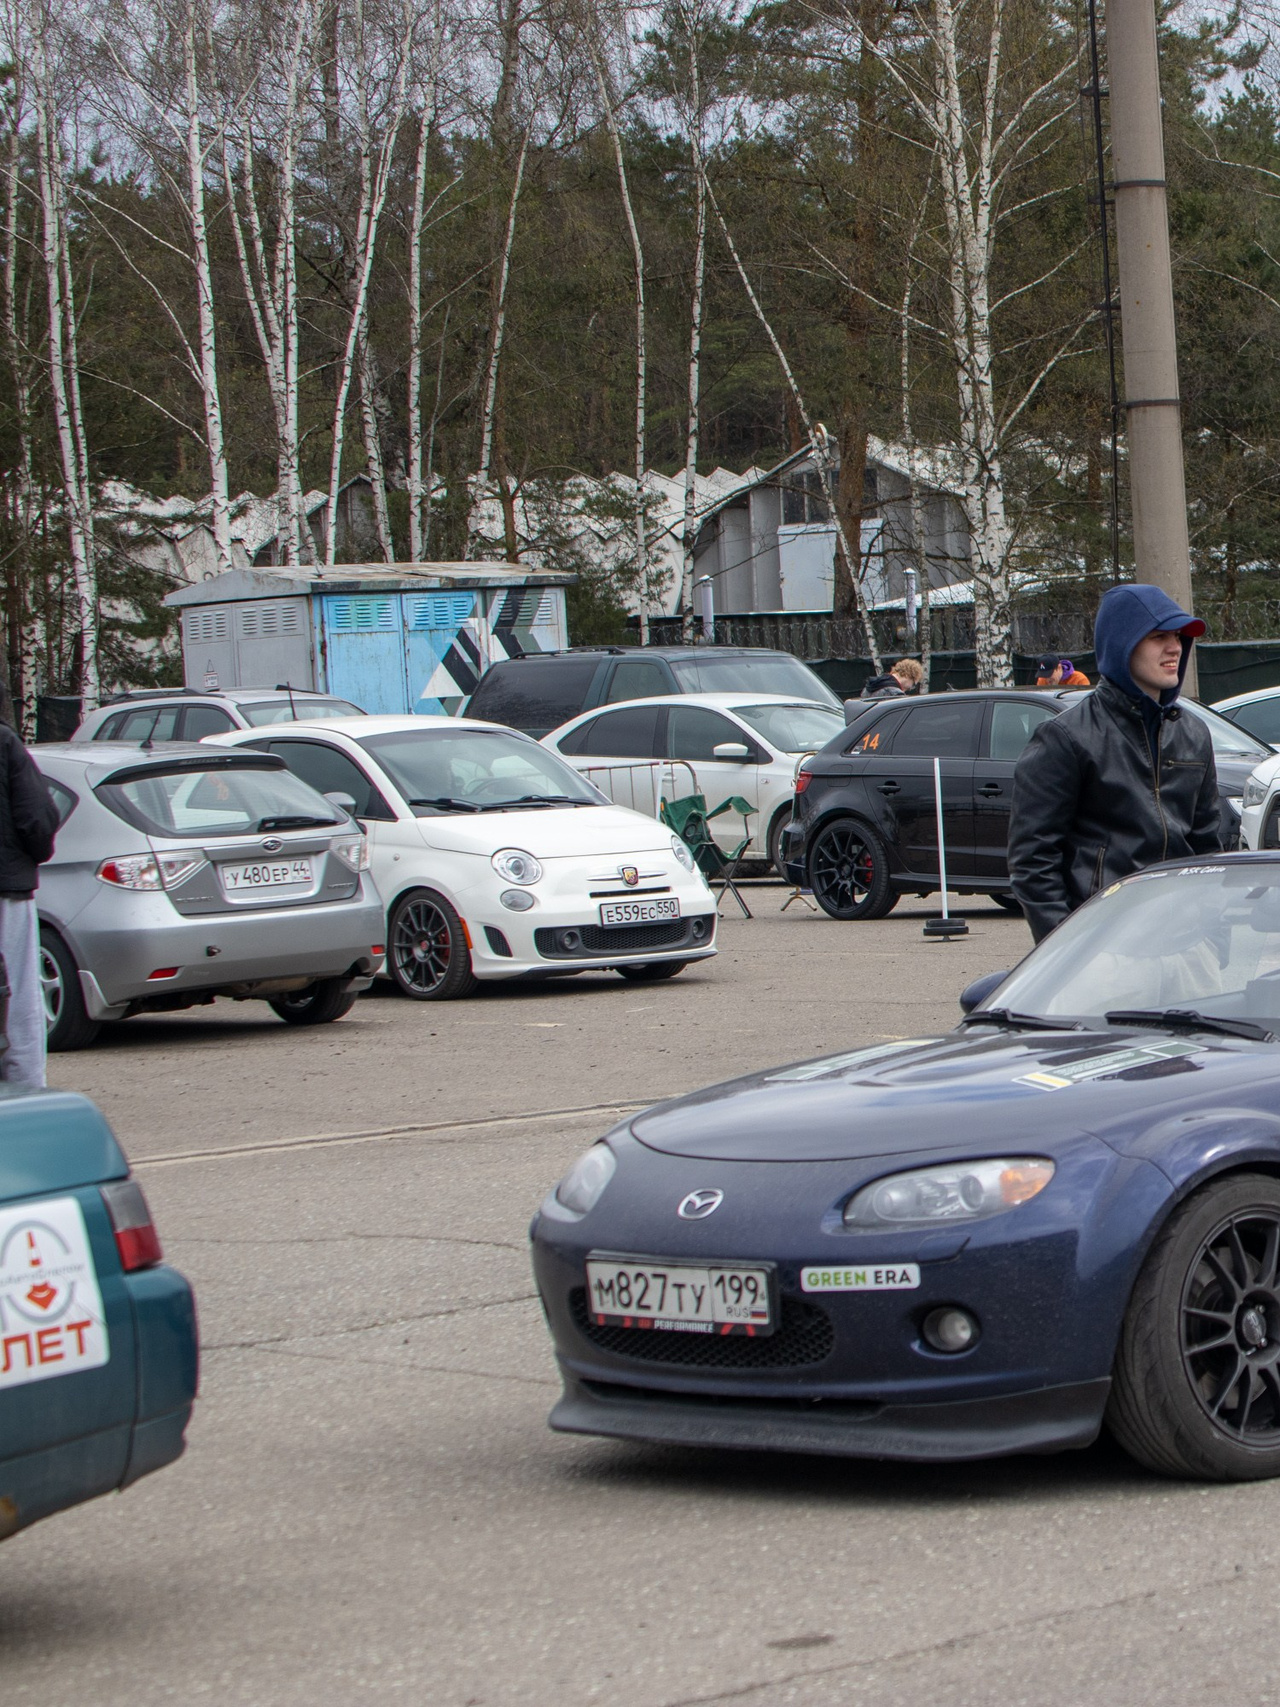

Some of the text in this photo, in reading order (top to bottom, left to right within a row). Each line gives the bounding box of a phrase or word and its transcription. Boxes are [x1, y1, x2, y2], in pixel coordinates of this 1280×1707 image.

[863, 733, 880, 750] 14
[293, 862, 307, 876] 44
[657, 901, 676, 914] 550
[807, 1269, 911, 1286] GREEN ERA
[597, 1271, 758, 1314] М827ТУ 199
[726, 1306, 749, 1318] RUS
[654, 1319, 715, 1333] PERFORMANCE
